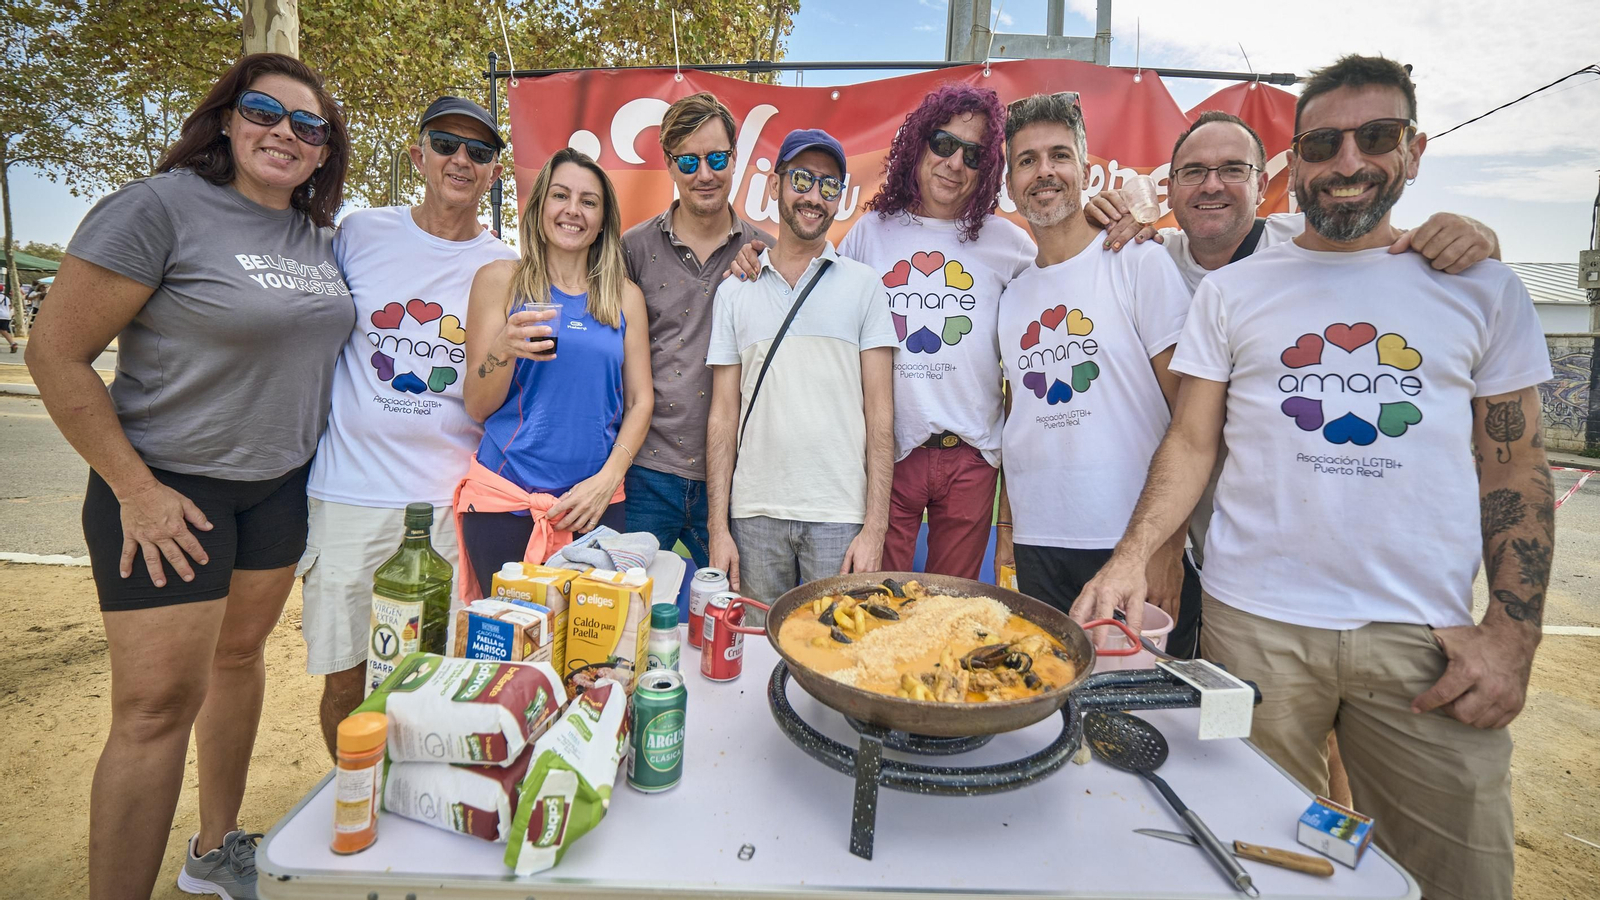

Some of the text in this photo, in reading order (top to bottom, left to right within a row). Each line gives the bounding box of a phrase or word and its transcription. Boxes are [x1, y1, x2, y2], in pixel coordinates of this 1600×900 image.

[235, 253, 338, 280] BELIEVE IN
[367, 332, 465, 363] amare
[1018, 339, 1098, 370] amare
[893, 362, 957, 372] sociación LGTBI+
[900, 371, 944, 379] Puerto Real
[1278, 373, 1422, 396] amare
[373, 395, 442, 408] Asociación LGTBI+
[383, 404, 431, 415] Puerto Real
[1036, 409, 1092, 423] Asociación LGTBI+
[1044, 418, 1081, 429] Puerto Real
[1296, 452, 1403, 469] Asociación LGTBI+
[1313, 463, 1384, 478] Puerto Real
[505, 588, 531, 601] eliges
[587, 593, 614, 608] eliges
[374, 602, 402, 617] VIRGEN
[376, 613, 398, 626] EXTRA
[573, 616, 616, 631] Caldo para
[476, 634, 498, 646] PAELLA
[572, 628, 598, 639] Paella
[379, 631, 393, 655] Y
[472, 641, 507, 658] MARISCO
[369, 660, 393, 673] YBARR
[460, 664, 493, 699] sabroz
[489, 667, 520, 697] brillante
[646, 725, 685, 749] ARGUS
[539, 798, 560, 845] sabroz
